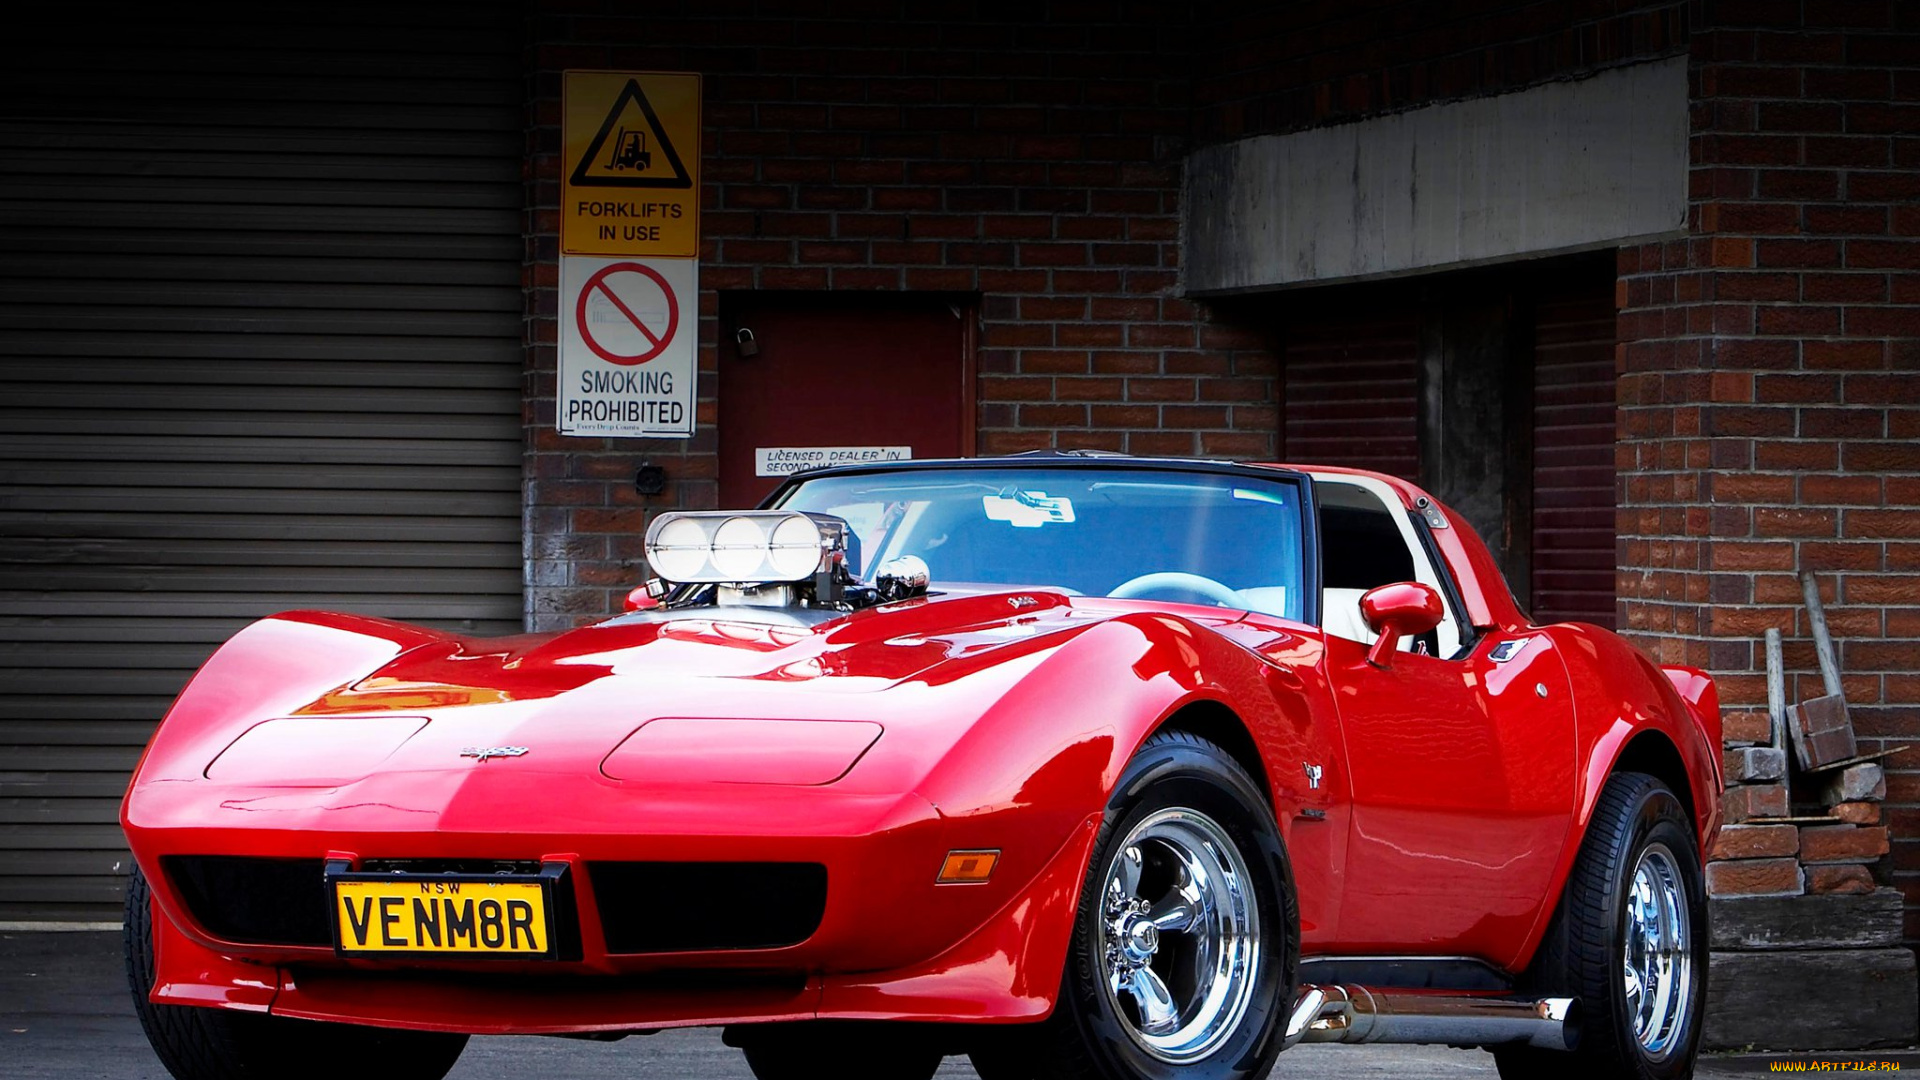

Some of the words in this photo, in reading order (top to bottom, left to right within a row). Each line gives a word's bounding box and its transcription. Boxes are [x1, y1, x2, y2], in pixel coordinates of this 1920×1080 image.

[578, 201, 682, 219] FORKLIFTS
[599, 225, 616, 240] IN
[623, 226, 660, 241] USE
[581, 370, 673, 394] SMOKING
[569, 399, 684, 424] PROHIBITED
[767, 451, 824, 461] LICENSED
[829, 451, 879, 461] DEALER
[886, 451, 901, 461] IN
[420, 882, 461, 894] NSW
[343, 896, 538, 950] VENM8R
